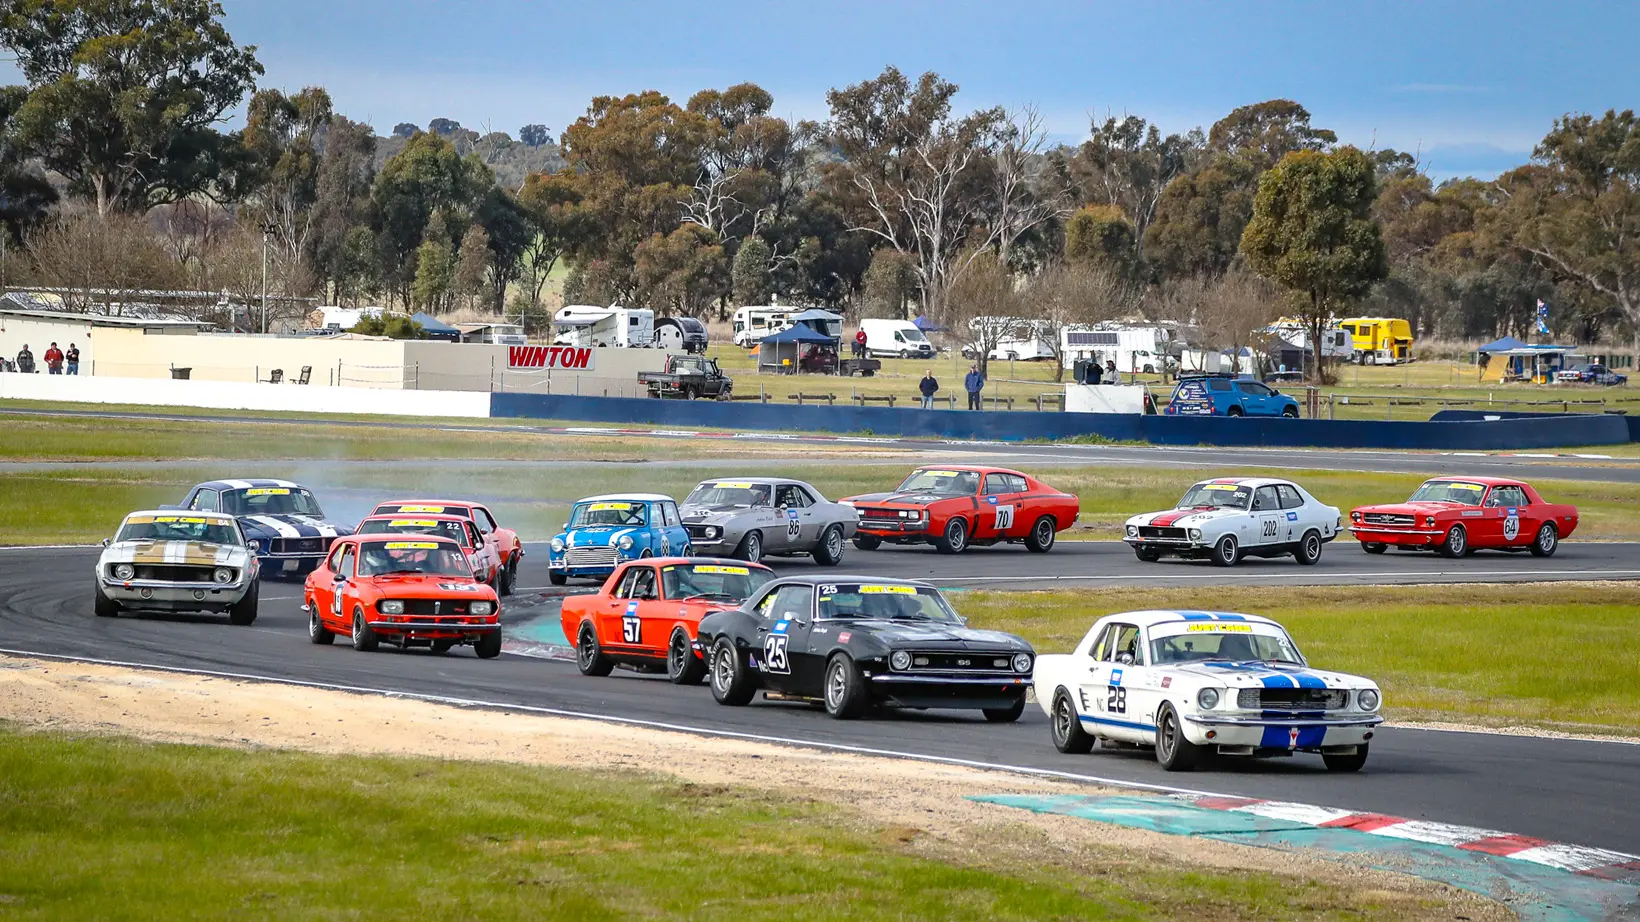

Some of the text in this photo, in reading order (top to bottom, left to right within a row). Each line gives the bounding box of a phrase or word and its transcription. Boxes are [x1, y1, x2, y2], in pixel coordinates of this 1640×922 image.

[509, 346, 592, 368] WINTON
[446, 522, 460, 530] 22
[788, 519, 800, 535] 86
[996, 510, 1009, 528] 70
[1504, 520, 1516, 535] 64
[1263, 520, 1277, 537] 202
[451, 552, 463, 561] 13
[821, 585, 838, 595] 25
[622, 616, 641, 642] 57
[766, 637, 786, 669] 25
[1107, 685, 1126, 713] 28
